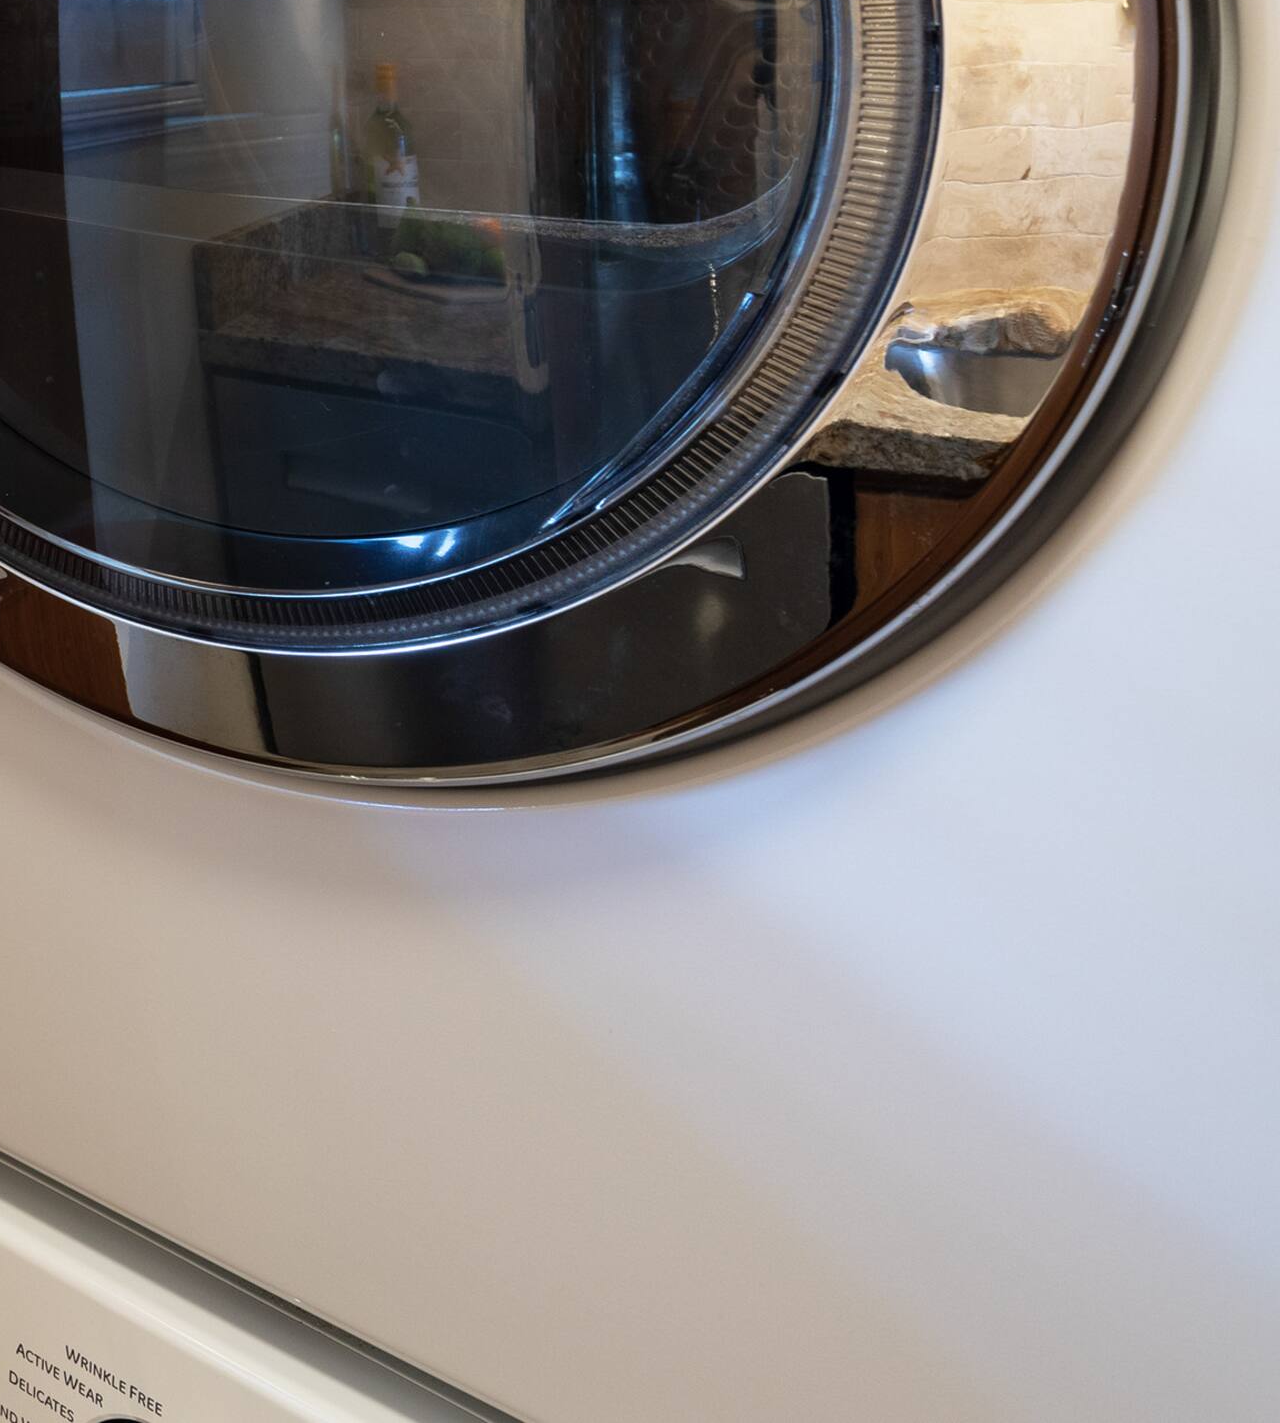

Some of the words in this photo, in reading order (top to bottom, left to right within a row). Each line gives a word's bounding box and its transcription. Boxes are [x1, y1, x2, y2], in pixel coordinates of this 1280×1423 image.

[8, 1369, 74, 1423] DELICATES
[15, 1343, 60, 1380] ACTIVE
[63, 1370, 103, 1408] WEAR
[65, 1345, 126, 1394] WRINKLE
[129, 1385, 162, 1417] FREE
